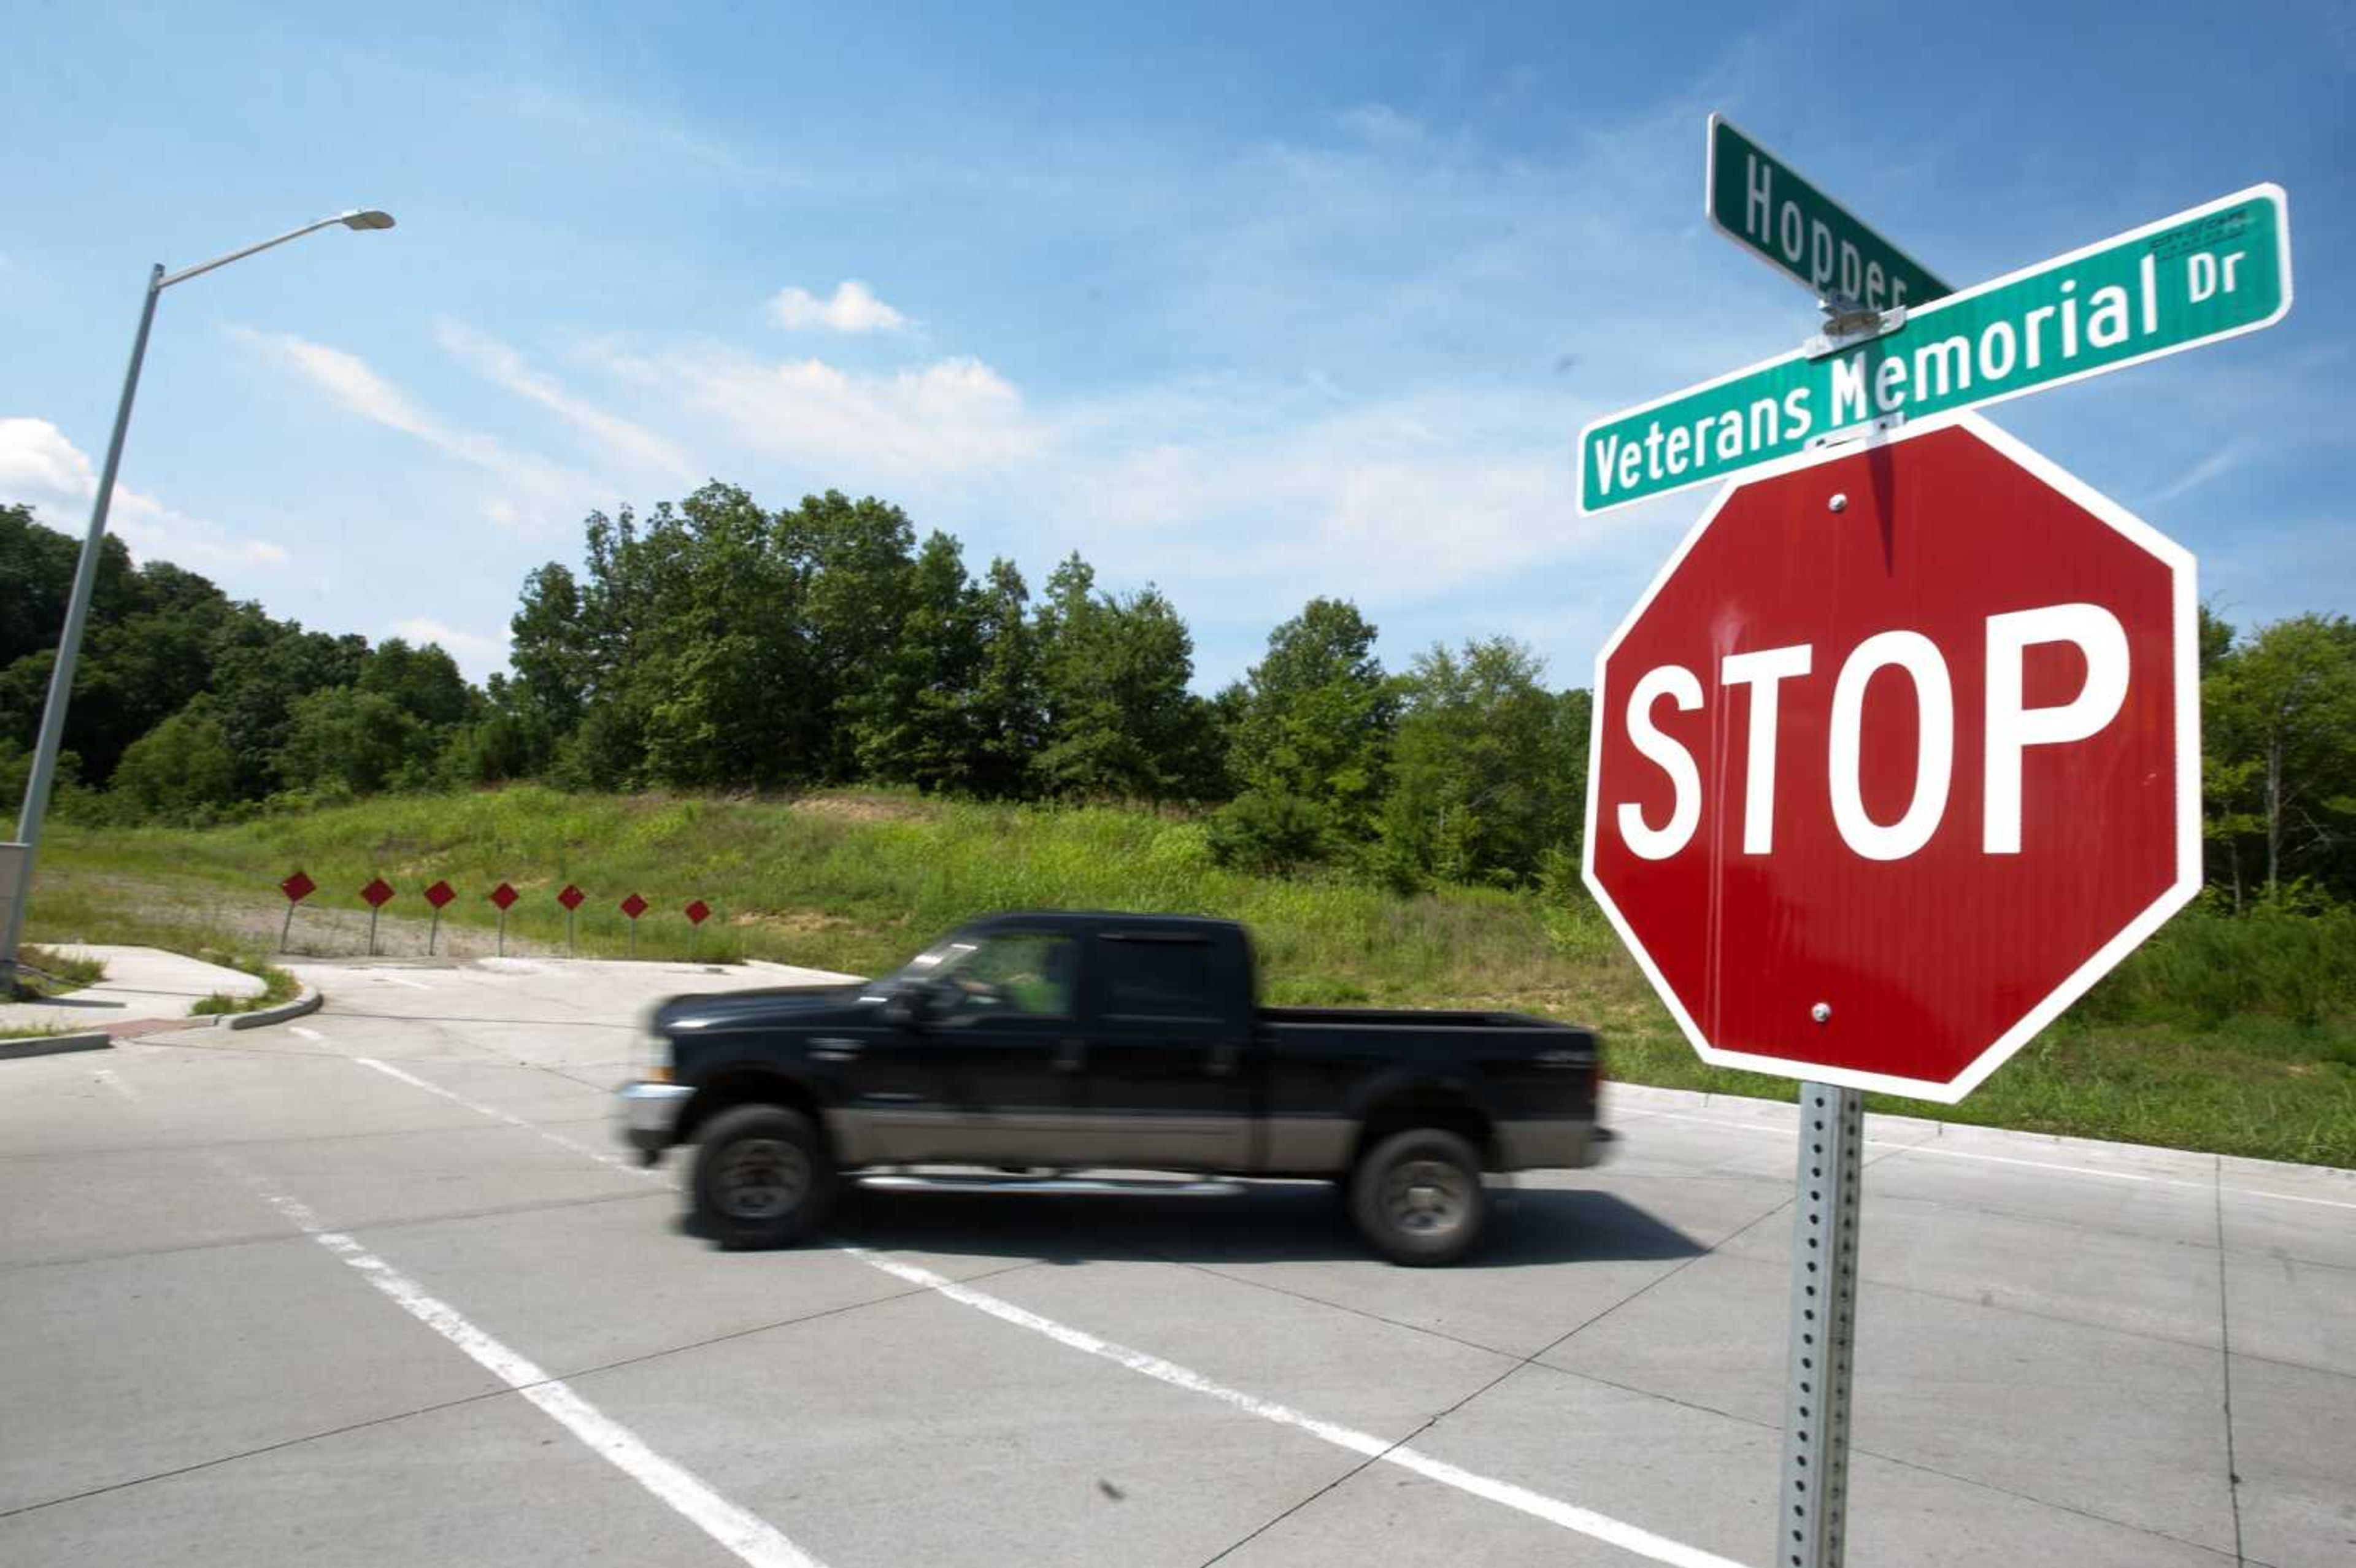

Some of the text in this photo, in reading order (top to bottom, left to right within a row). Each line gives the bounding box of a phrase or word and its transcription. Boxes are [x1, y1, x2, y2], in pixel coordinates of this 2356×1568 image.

[1747, 153, 1907, 312] Hopper
[1595, 250, 2246, 496] Veterans Memorial Dr
[1617, 602, 2130, 860] STOP
